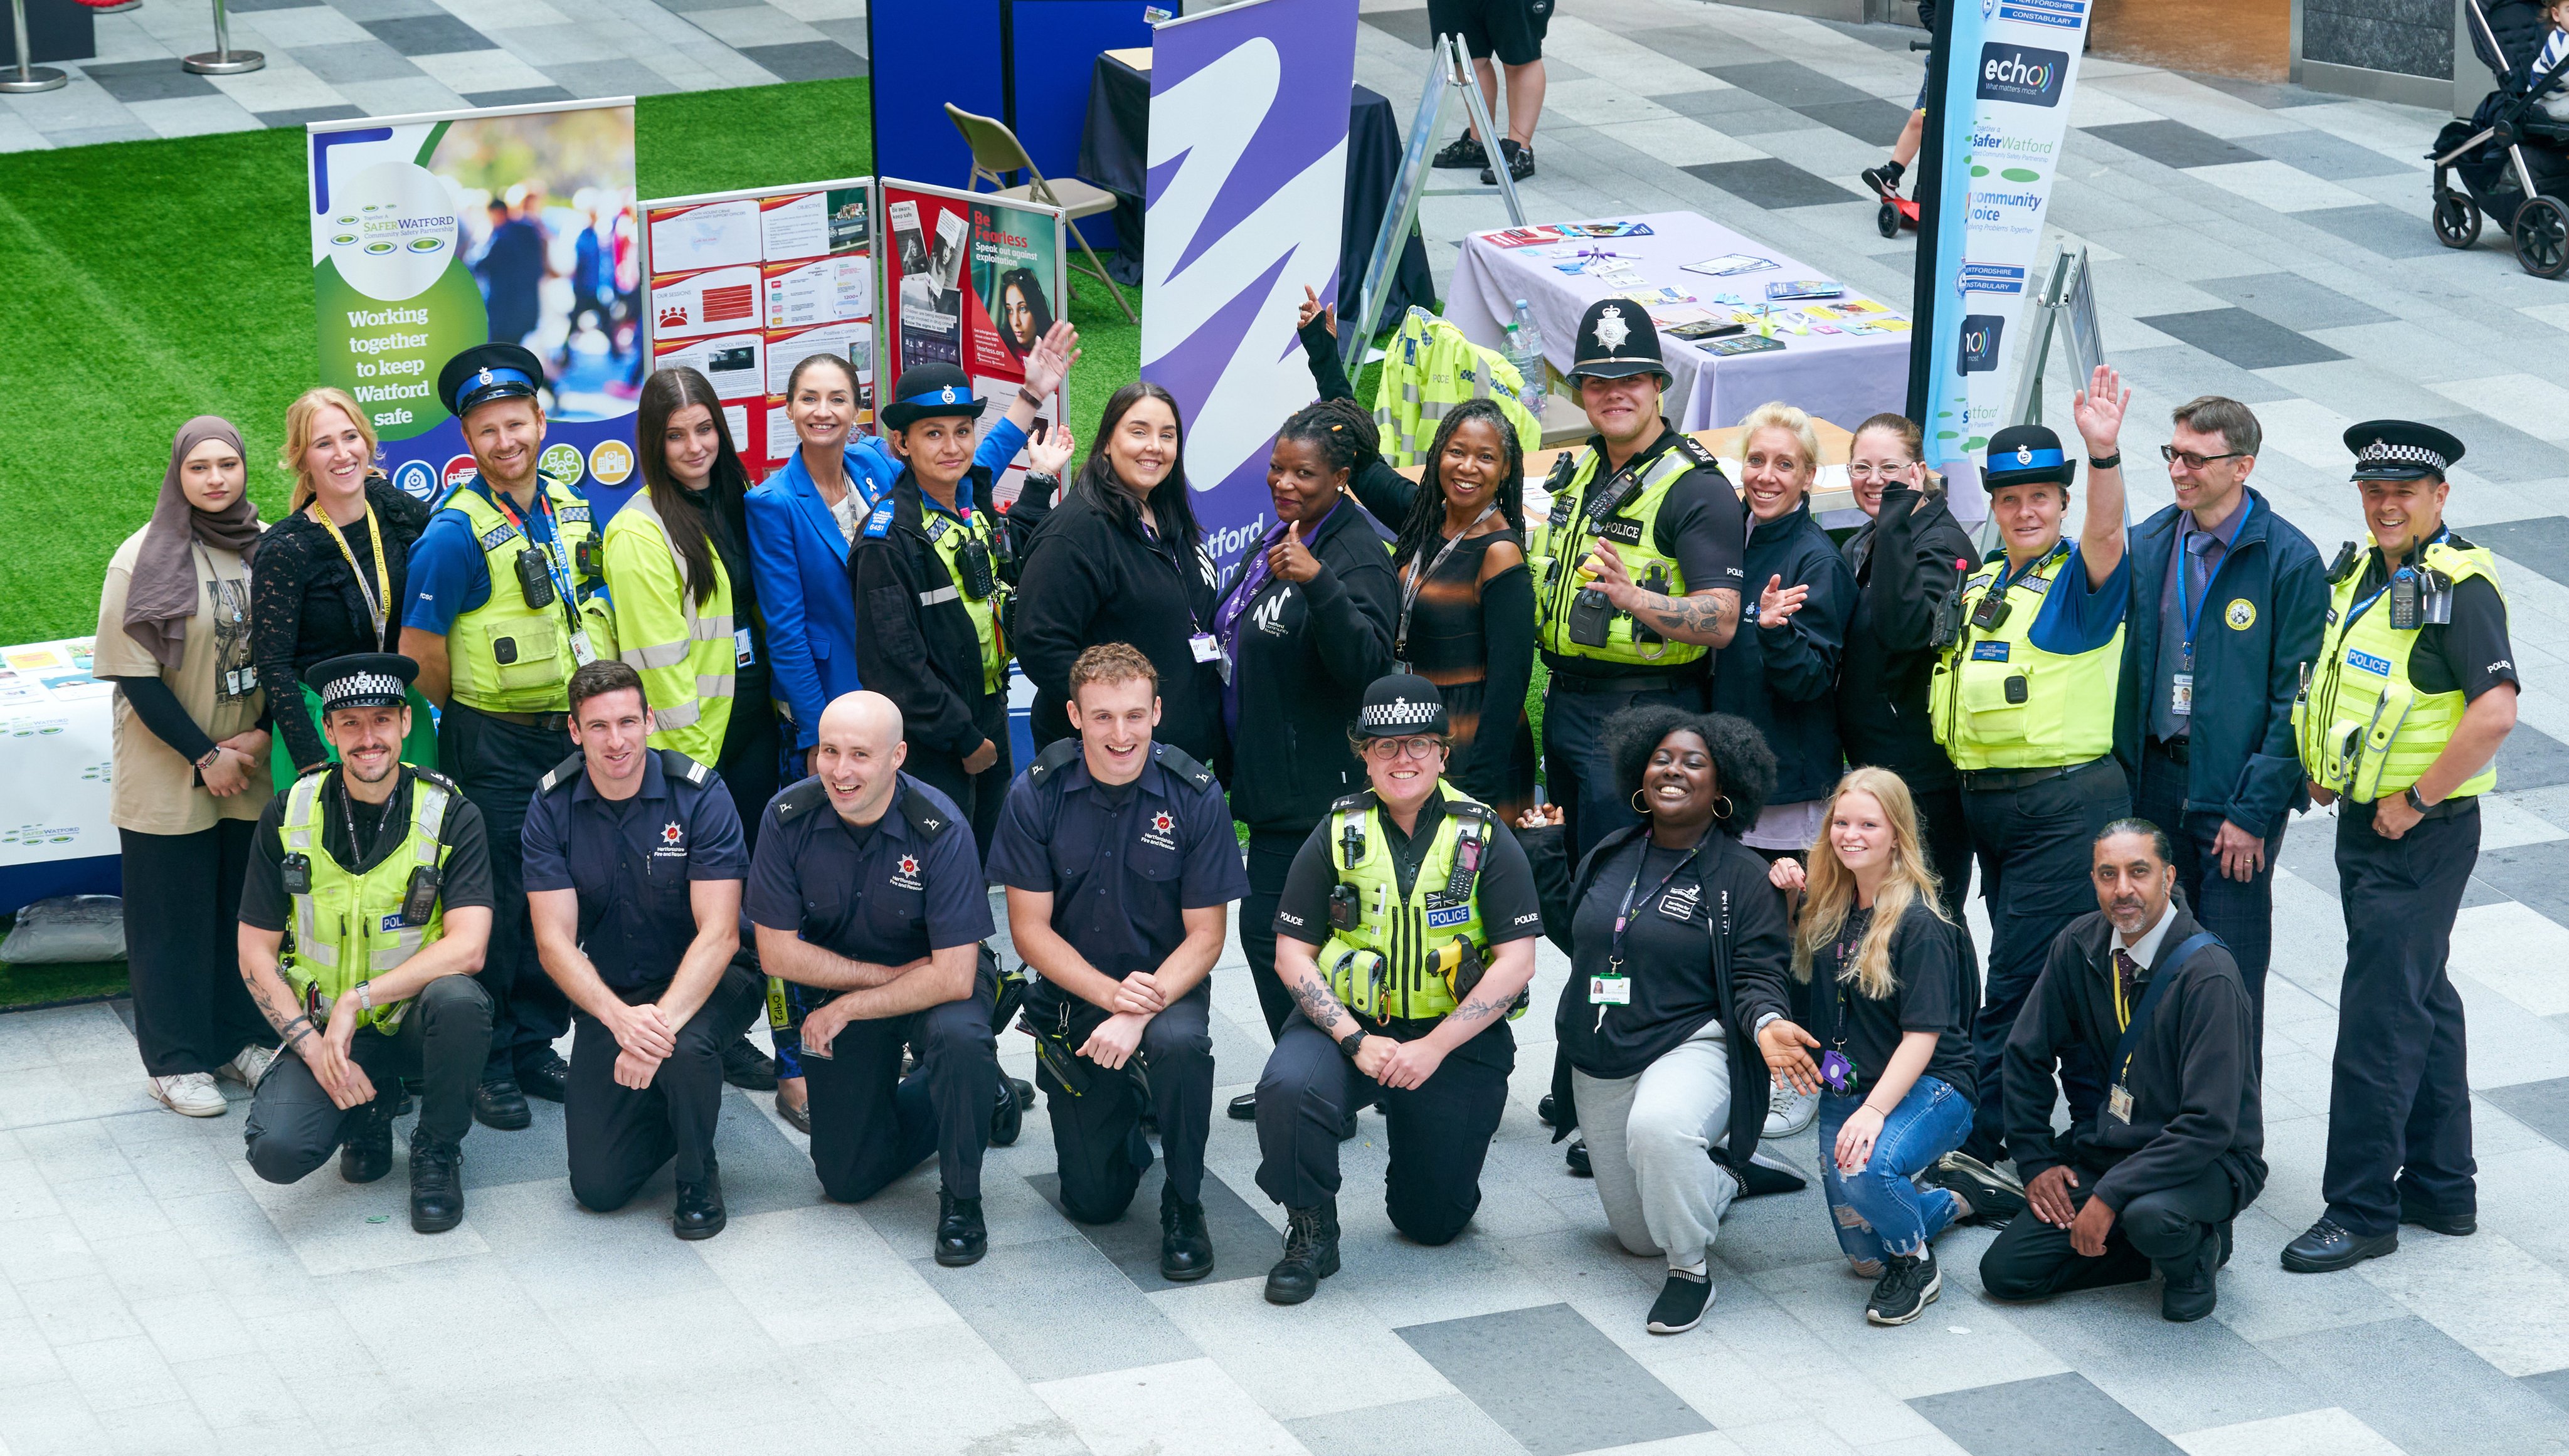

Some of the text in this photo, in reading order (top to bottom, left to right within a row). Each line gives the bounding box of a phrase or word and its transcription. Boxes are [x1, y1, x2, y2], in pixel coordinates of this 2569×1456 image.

[2012, 11, 2072, 24] CONSTABULARY
[1984, 53, 2044, 86] echo
[1998, 84, 2021, 93] matters
[2006, 152, 2021, 161] Safety
[2021, 154, 2048, 163] Partnership
[797, 203, 821, 211] OBJECTIVE
[1971, 191, 2042, 211] community
[974, 210, 990, 227] Be
[1969, 206, 2000, 221] voice
[364, 228, 399, 239] Community
[420, 226, 455, 235] Partnership
[1984, 224, 2008, 232] Problems
[2010, 226, 2034, 234] Together
[975, 226, 1028, 248] Fearless
[975, 241, 1037, 261] Speak out against
[976, 253, 1017, 266] exploitation
[1966, 266, 2012, 275] ERTFORDSHIRE
[347, 307, 428, 328] Working
[349, 332, 429, 355] together
[976, 344, 1005, 358] fearless.org
[356, 359, 425, 377] to keep
[1433, 374, 1449, 384] POCE
[353, 380, 430, 403] Watford
[374, 408, 413, 426] safe
[1199, 512, 1264, 560] tford
[1604, 521, 1639, 539] POLICE
[371, 530, 384, 572] Contractor
[1727, 567, 1744, 578] POLIC
[2226, 599, 2257, 620] NEIGHBOURHOOD
[2344, 601, 2369, 623] FEDERATION
[1267, 620, 1285, 629] watford
[2348, 651, 2388, 674] POLICE
[2487, 660, 2512, 673] POLICE
[1145, 833, 1174, 845] Hertfordshire
[1159, 841, 1175, 851] Rescue
[892, 875, 922, 887] Hertfordshire
[384, 916, 405, 929] POL
[1280, 911, 1304, 926] POLICE
[1431, 909, 1467, 925] POLICE
[1514, 913, 1539, 926] POLICE
